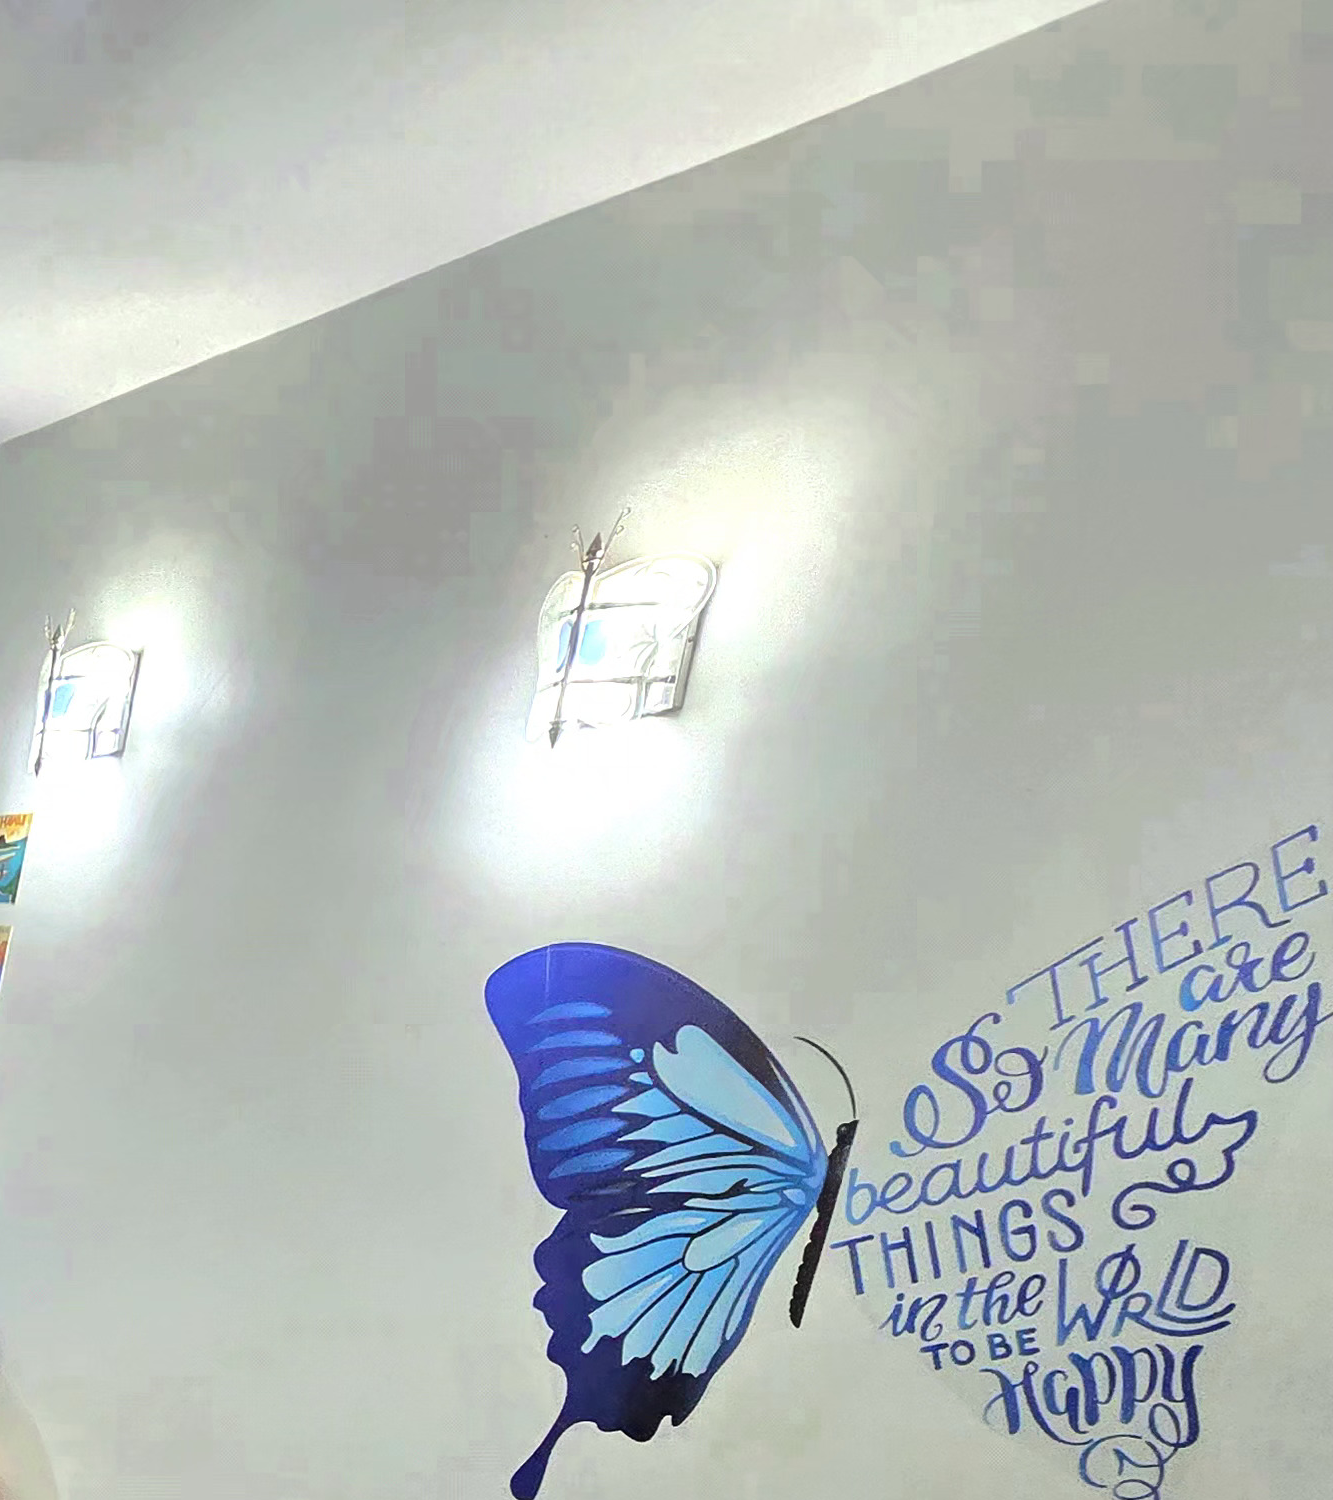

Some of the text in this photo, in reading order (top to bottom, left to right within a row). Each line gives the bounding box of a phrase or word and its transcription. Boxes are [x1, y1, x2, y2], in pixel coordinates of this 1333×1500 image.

[1006, 824, 1329, 1031] THERE
[1178, 931, 1317, 1012] are
[889, 981, 1333, 1158] So Many
[845, 1077, 1243, 1226] beautiful
[829, 1187, 1085, 1296] THINGS
[879, 1291, 948, 1342] in
[956, 1269, 1048, 1331] the
[919, 1327, 1041, 1371] TO BE
[979, 1343, 1204, 1449] Happy
